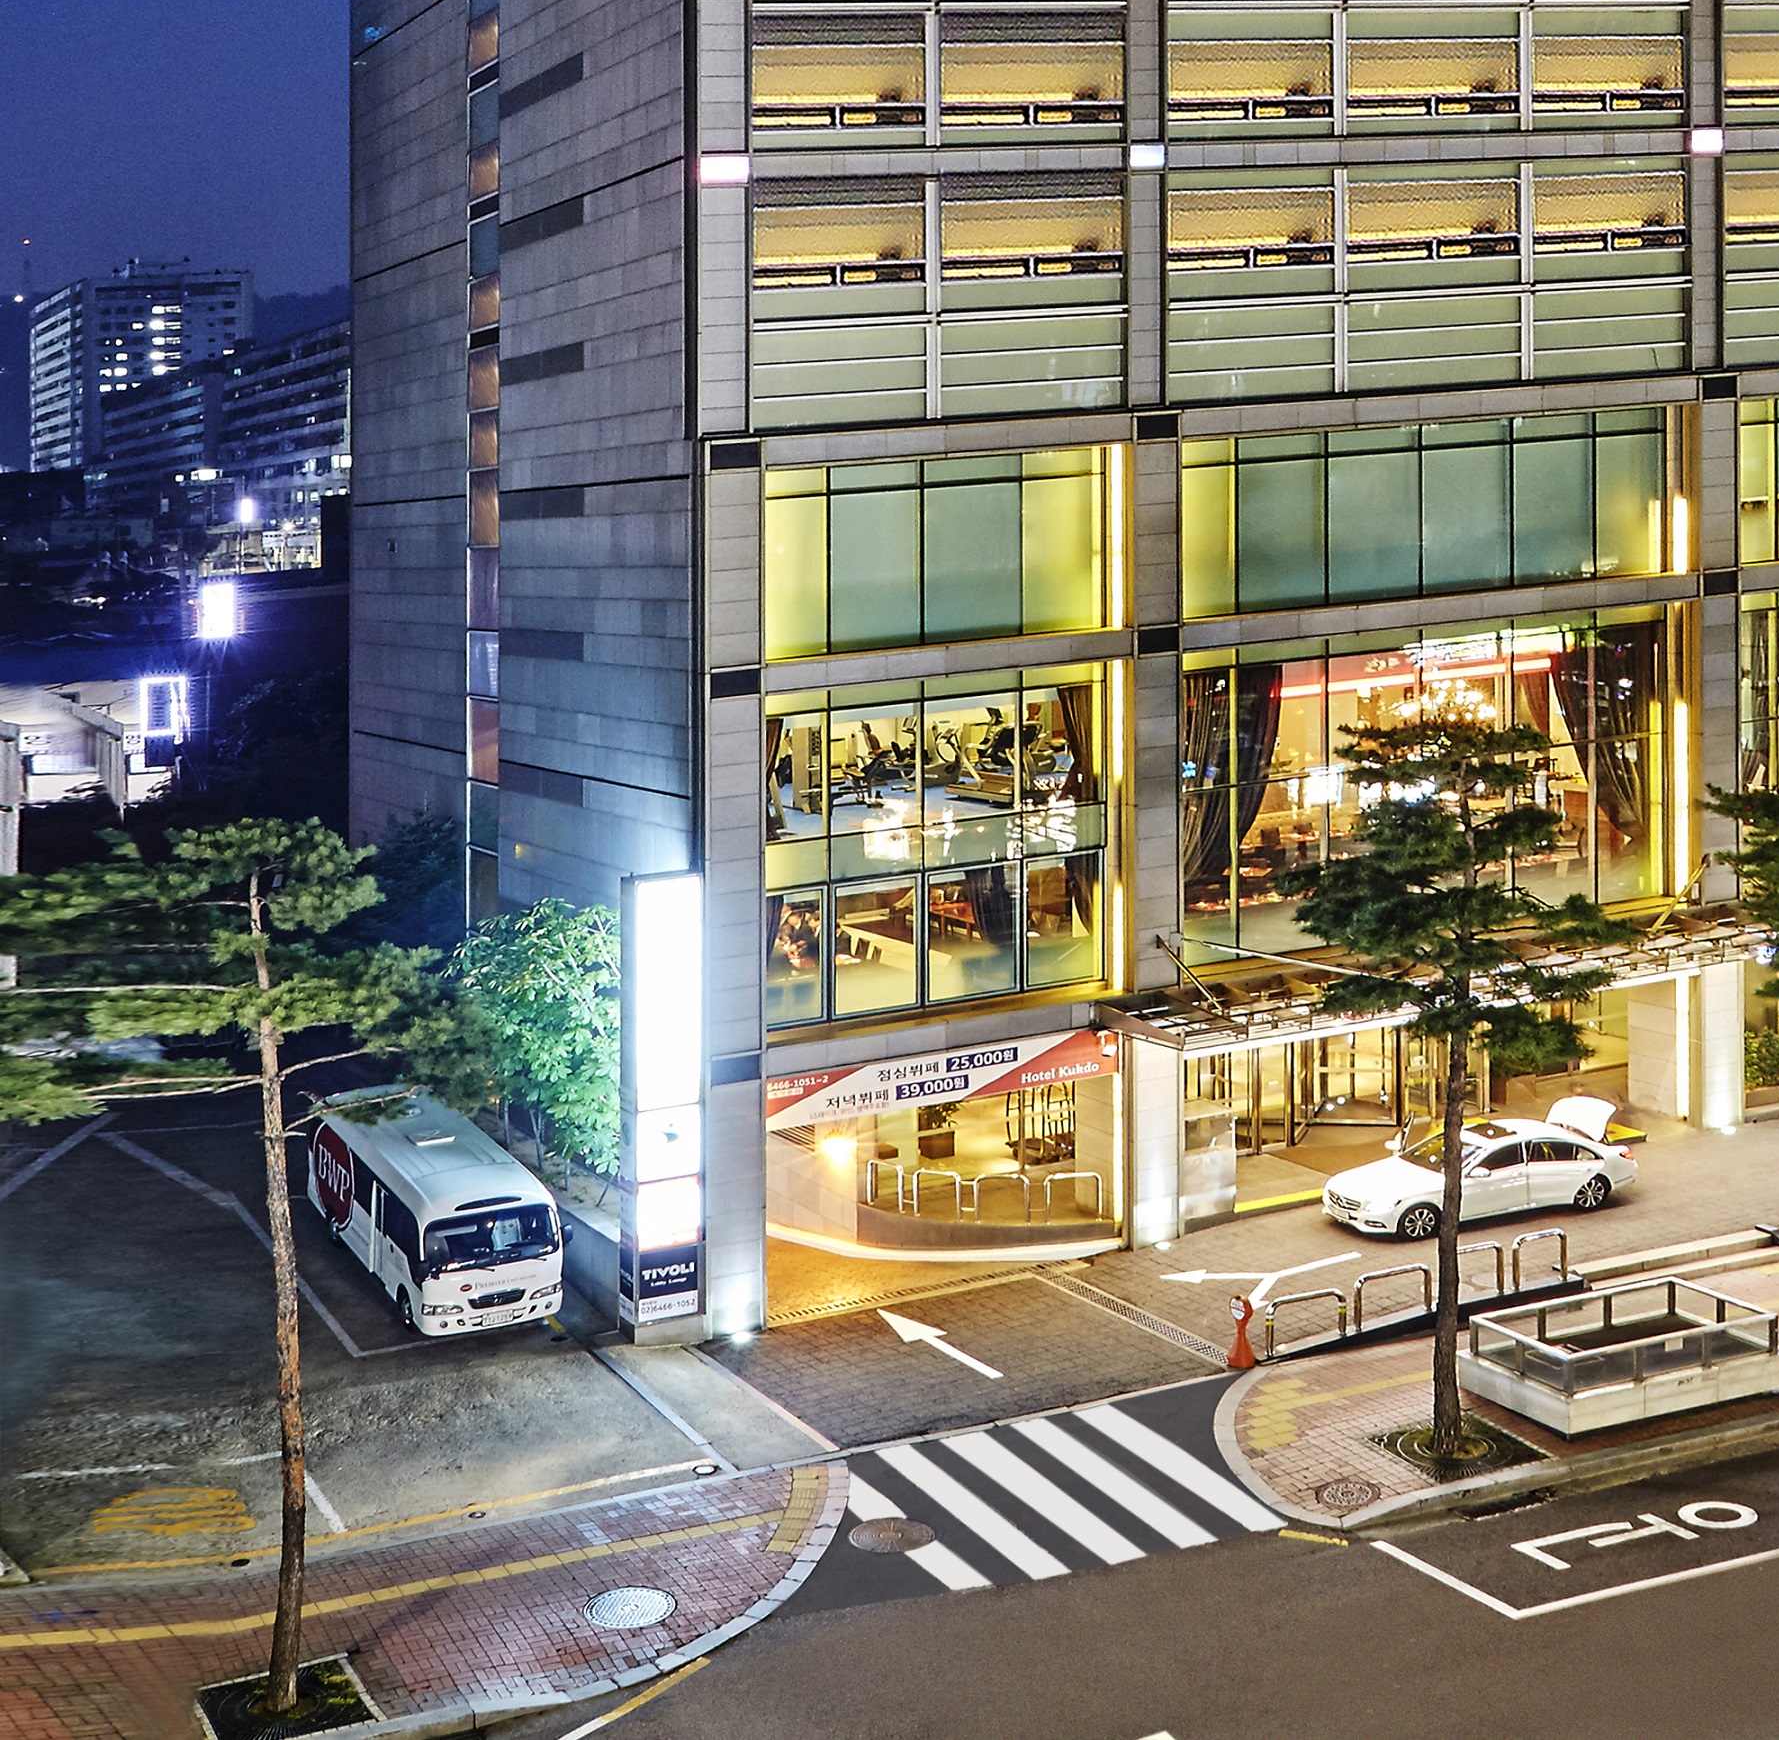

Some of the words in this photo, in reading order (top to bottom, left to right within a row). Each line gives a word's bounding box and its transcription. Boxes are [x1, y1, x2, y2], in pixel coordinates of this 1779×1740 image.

[877, 1061, 940, 1082] 점심뷔페
[950, 1048, 1014, 1071] 25,000원
[1021, 1068, 1055, 1085] Hotel
[1058, 1062, 1100, 1079] Kukdo
[826, 1089, 889, 1109] 저녁뷔페
[901, 1077, 965, 1099] 39,000원
[318, 1143, 350, 1203] BWP
[641, 1261, 695, 1281] TIVOLI
[640, 1298, 696, 1315] 02)6466-1052
